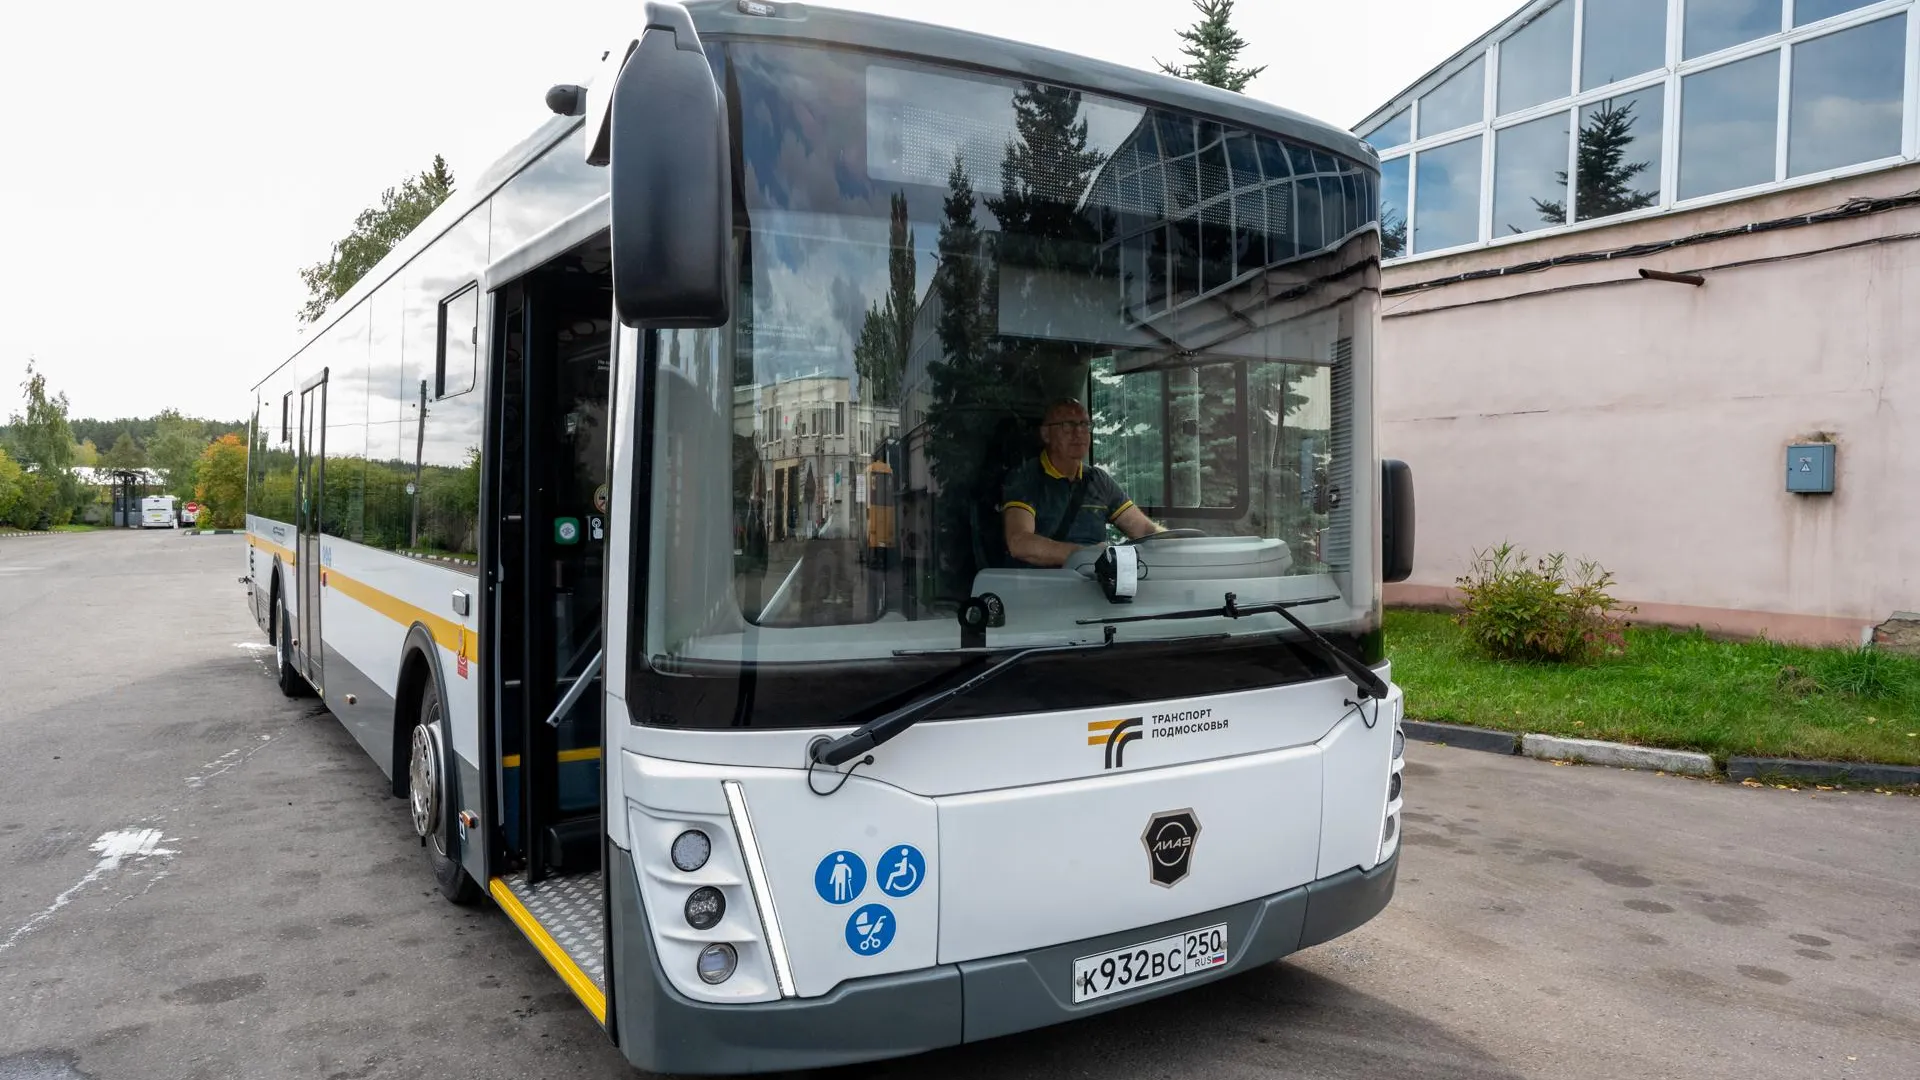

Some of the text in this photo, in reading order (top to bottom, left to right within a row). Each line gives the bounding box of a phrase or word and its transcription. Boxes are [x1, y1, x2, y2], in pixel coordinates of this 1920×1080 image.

[1152, 709, 1212, 724] ТРАНСПОРТ
[1152, 719, 1229, 738] ПОДМОСКОВЬЯ
[1152, 836, 1191, 851] ЛИАЗ
[1187, 930, 1220, 959] 250
[1194, 956, 1212, 967] RUS
